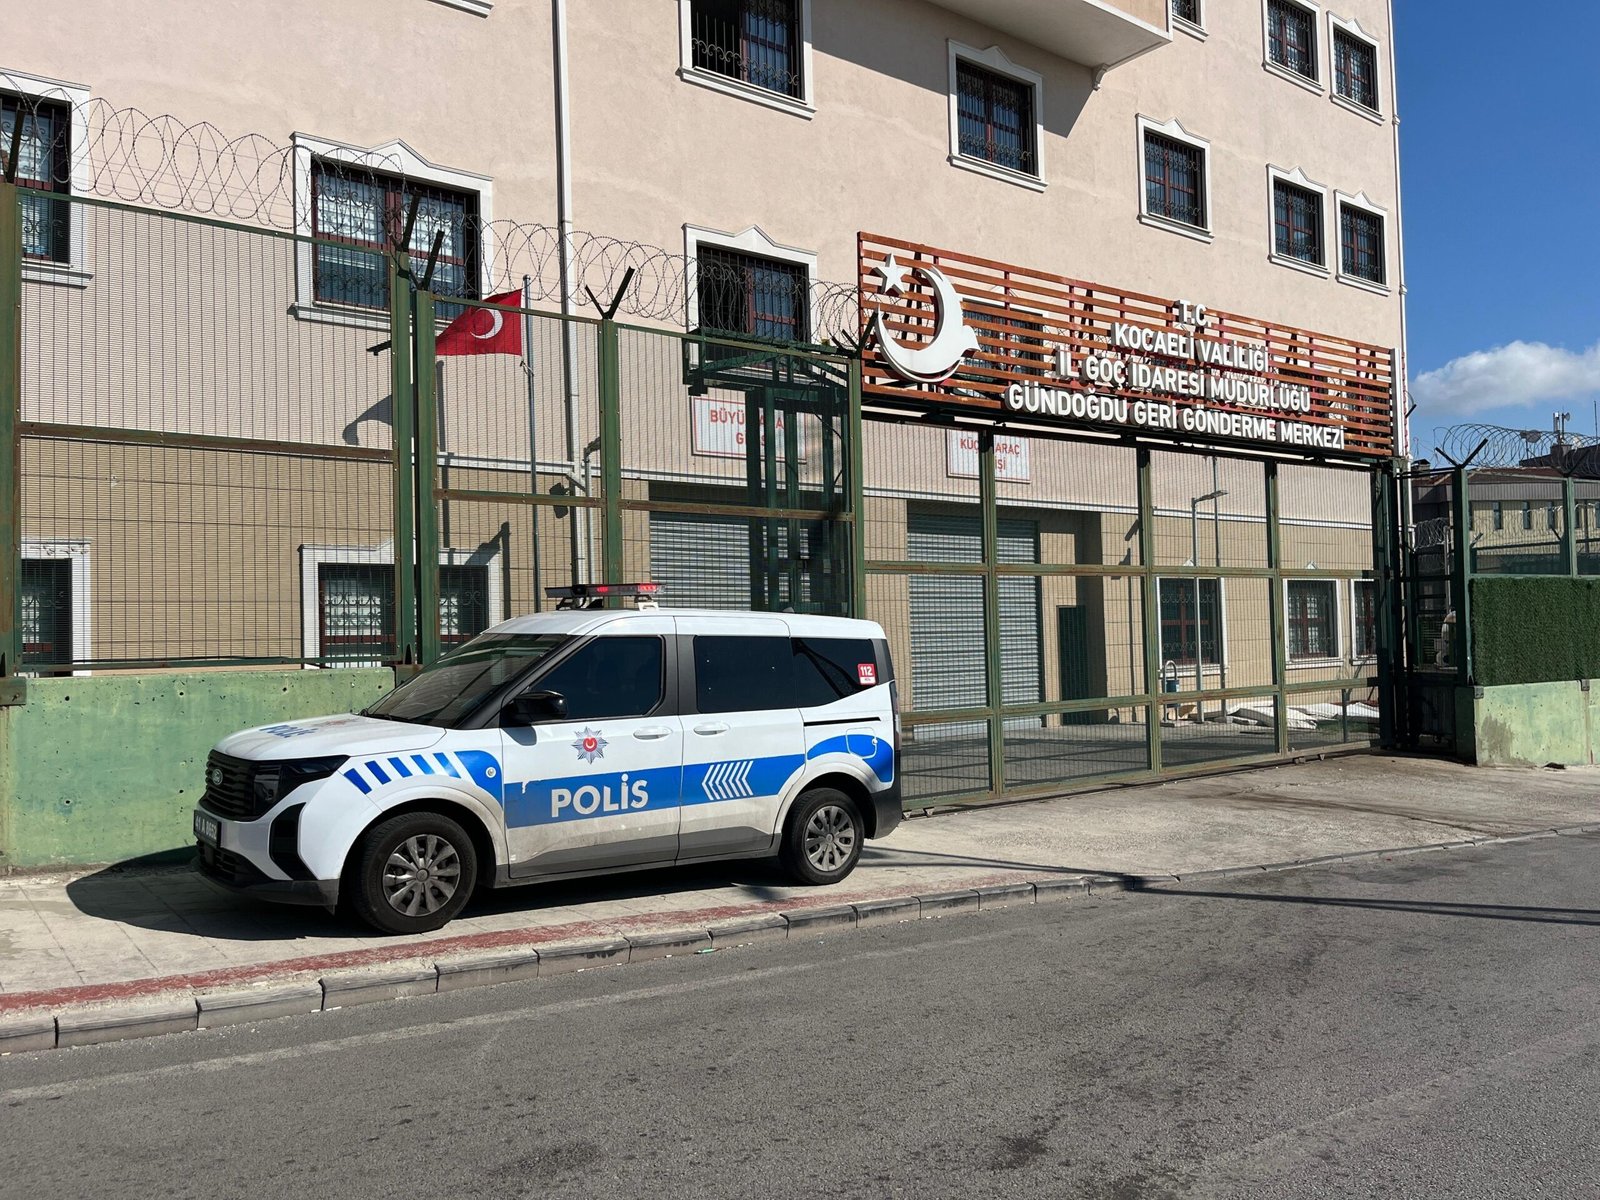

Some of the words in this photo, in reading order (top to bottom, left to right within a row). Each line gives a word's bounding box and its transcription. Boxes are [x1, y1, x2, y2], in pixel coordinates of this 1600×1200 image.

[1178, 299, 1212, 328] T.C.
[1113, 321, 1196, 360] KOCAELİ
[1199, 338, 1269, 373] VALİLİĞİ
[710, 408, 745, 424] BÜYÜ
[1008, 379, 1128, 423] GÜNDOĞDU
[1133, 400, 1178, 430] GERİ
[1182, 404, 1277, 441] GÖNDERME
[1280, 420, 1346, 451] MERKEZİ
[995, 443, 1020, 458] ARAÇ
[860, 665, 873, 676] 112
[551, 773, 649, 818] POLİS
